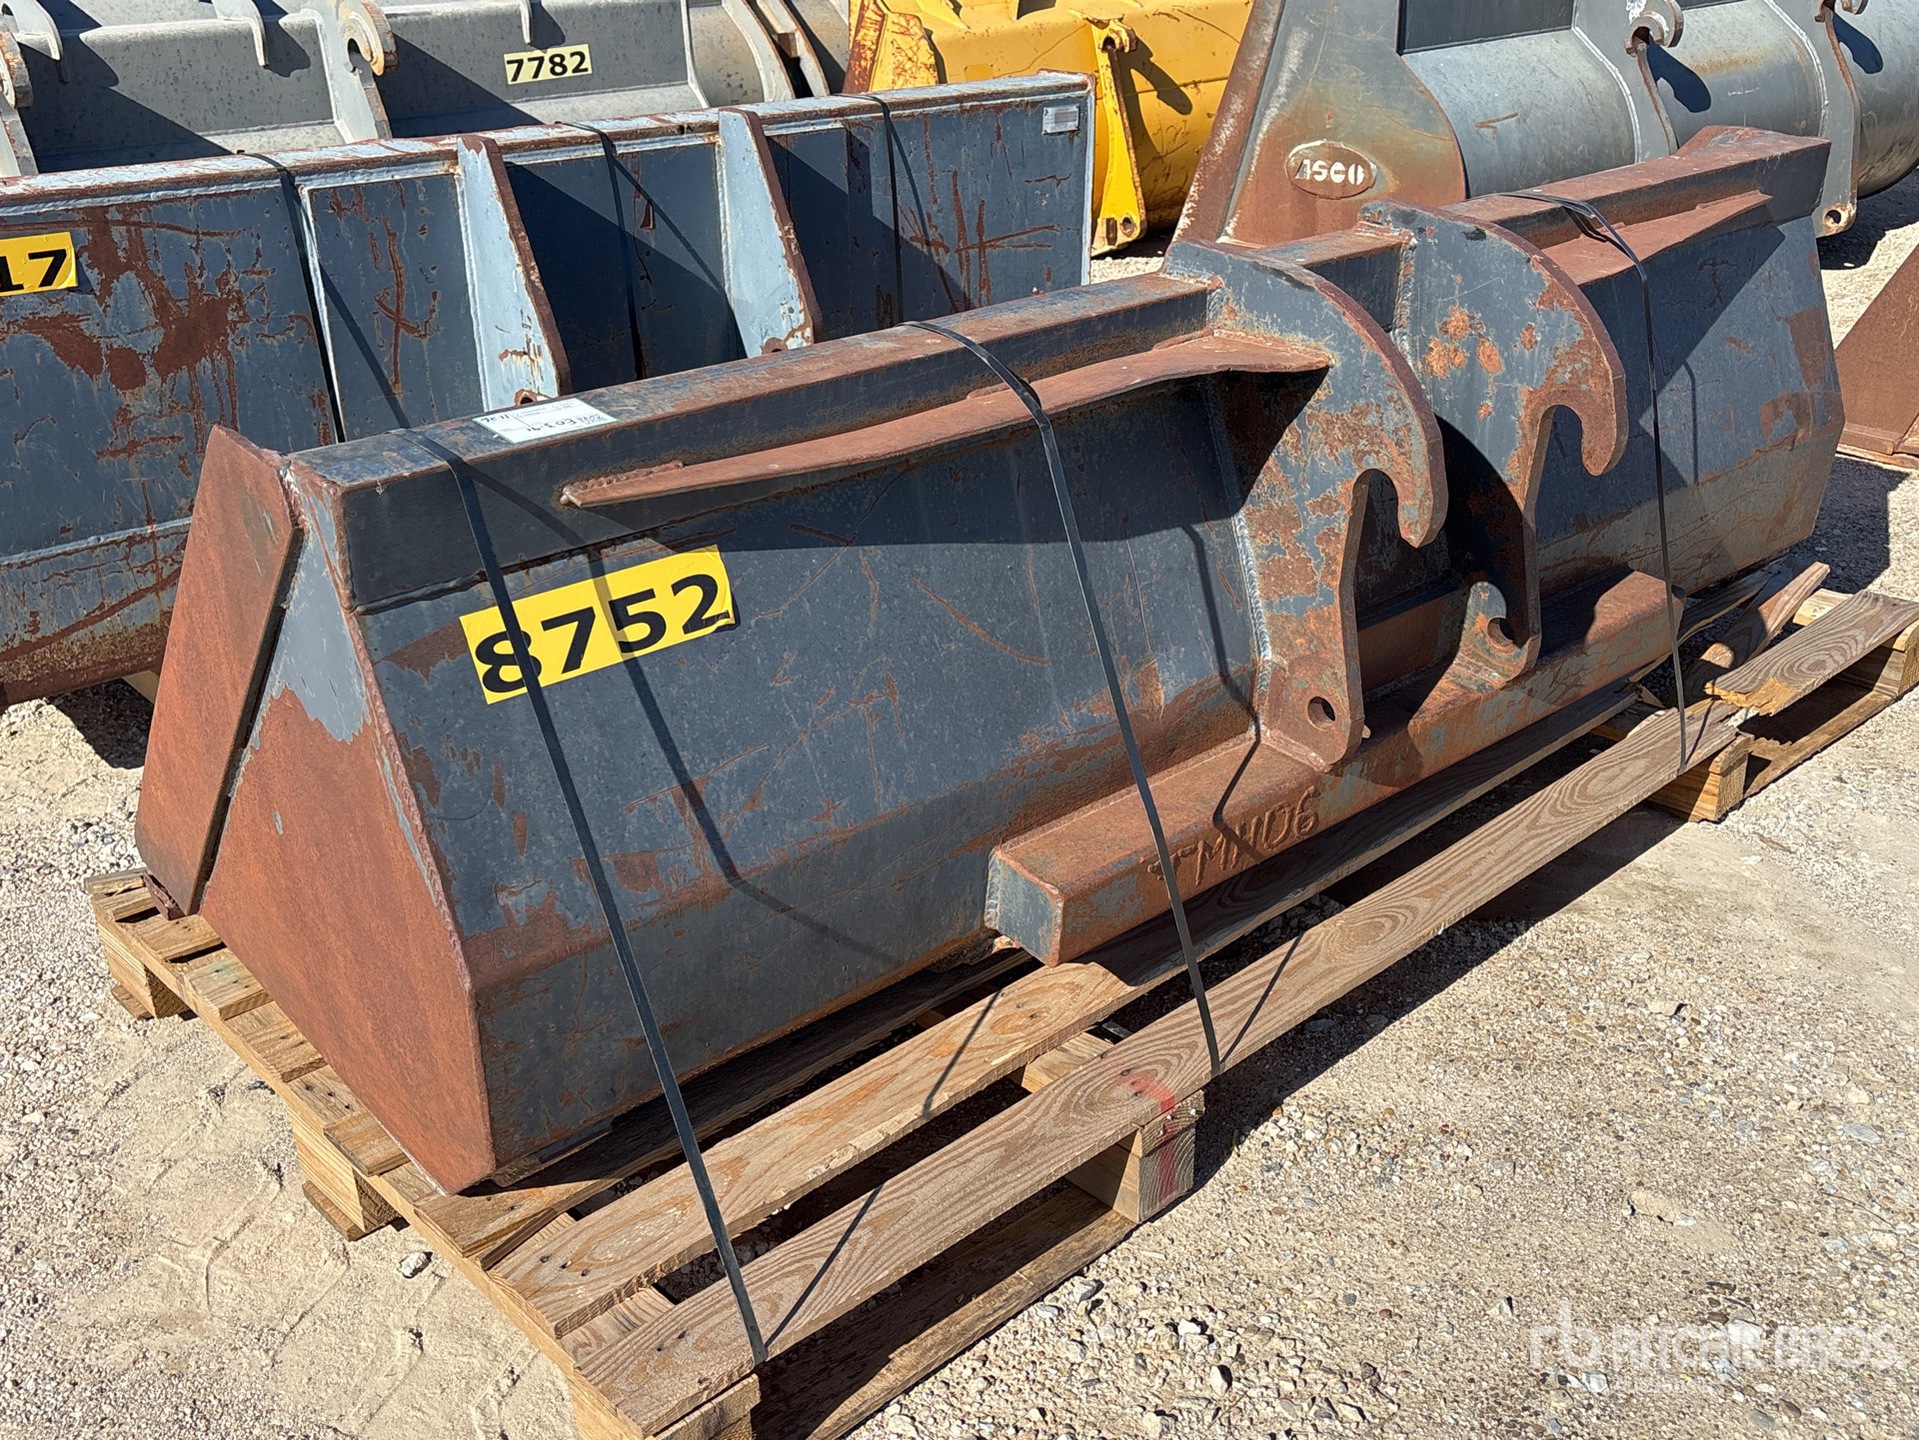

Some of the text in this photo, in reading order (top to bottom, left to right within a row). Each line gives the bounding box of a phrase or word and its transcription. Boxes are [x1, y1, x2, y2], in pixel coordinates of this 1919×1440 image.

[506, 51, 589, 82] 7782
[1294, 158, 1365, 186] ASCO
[0, 248, 68, 292] 17
[474, 573, 731, 694] 8752
